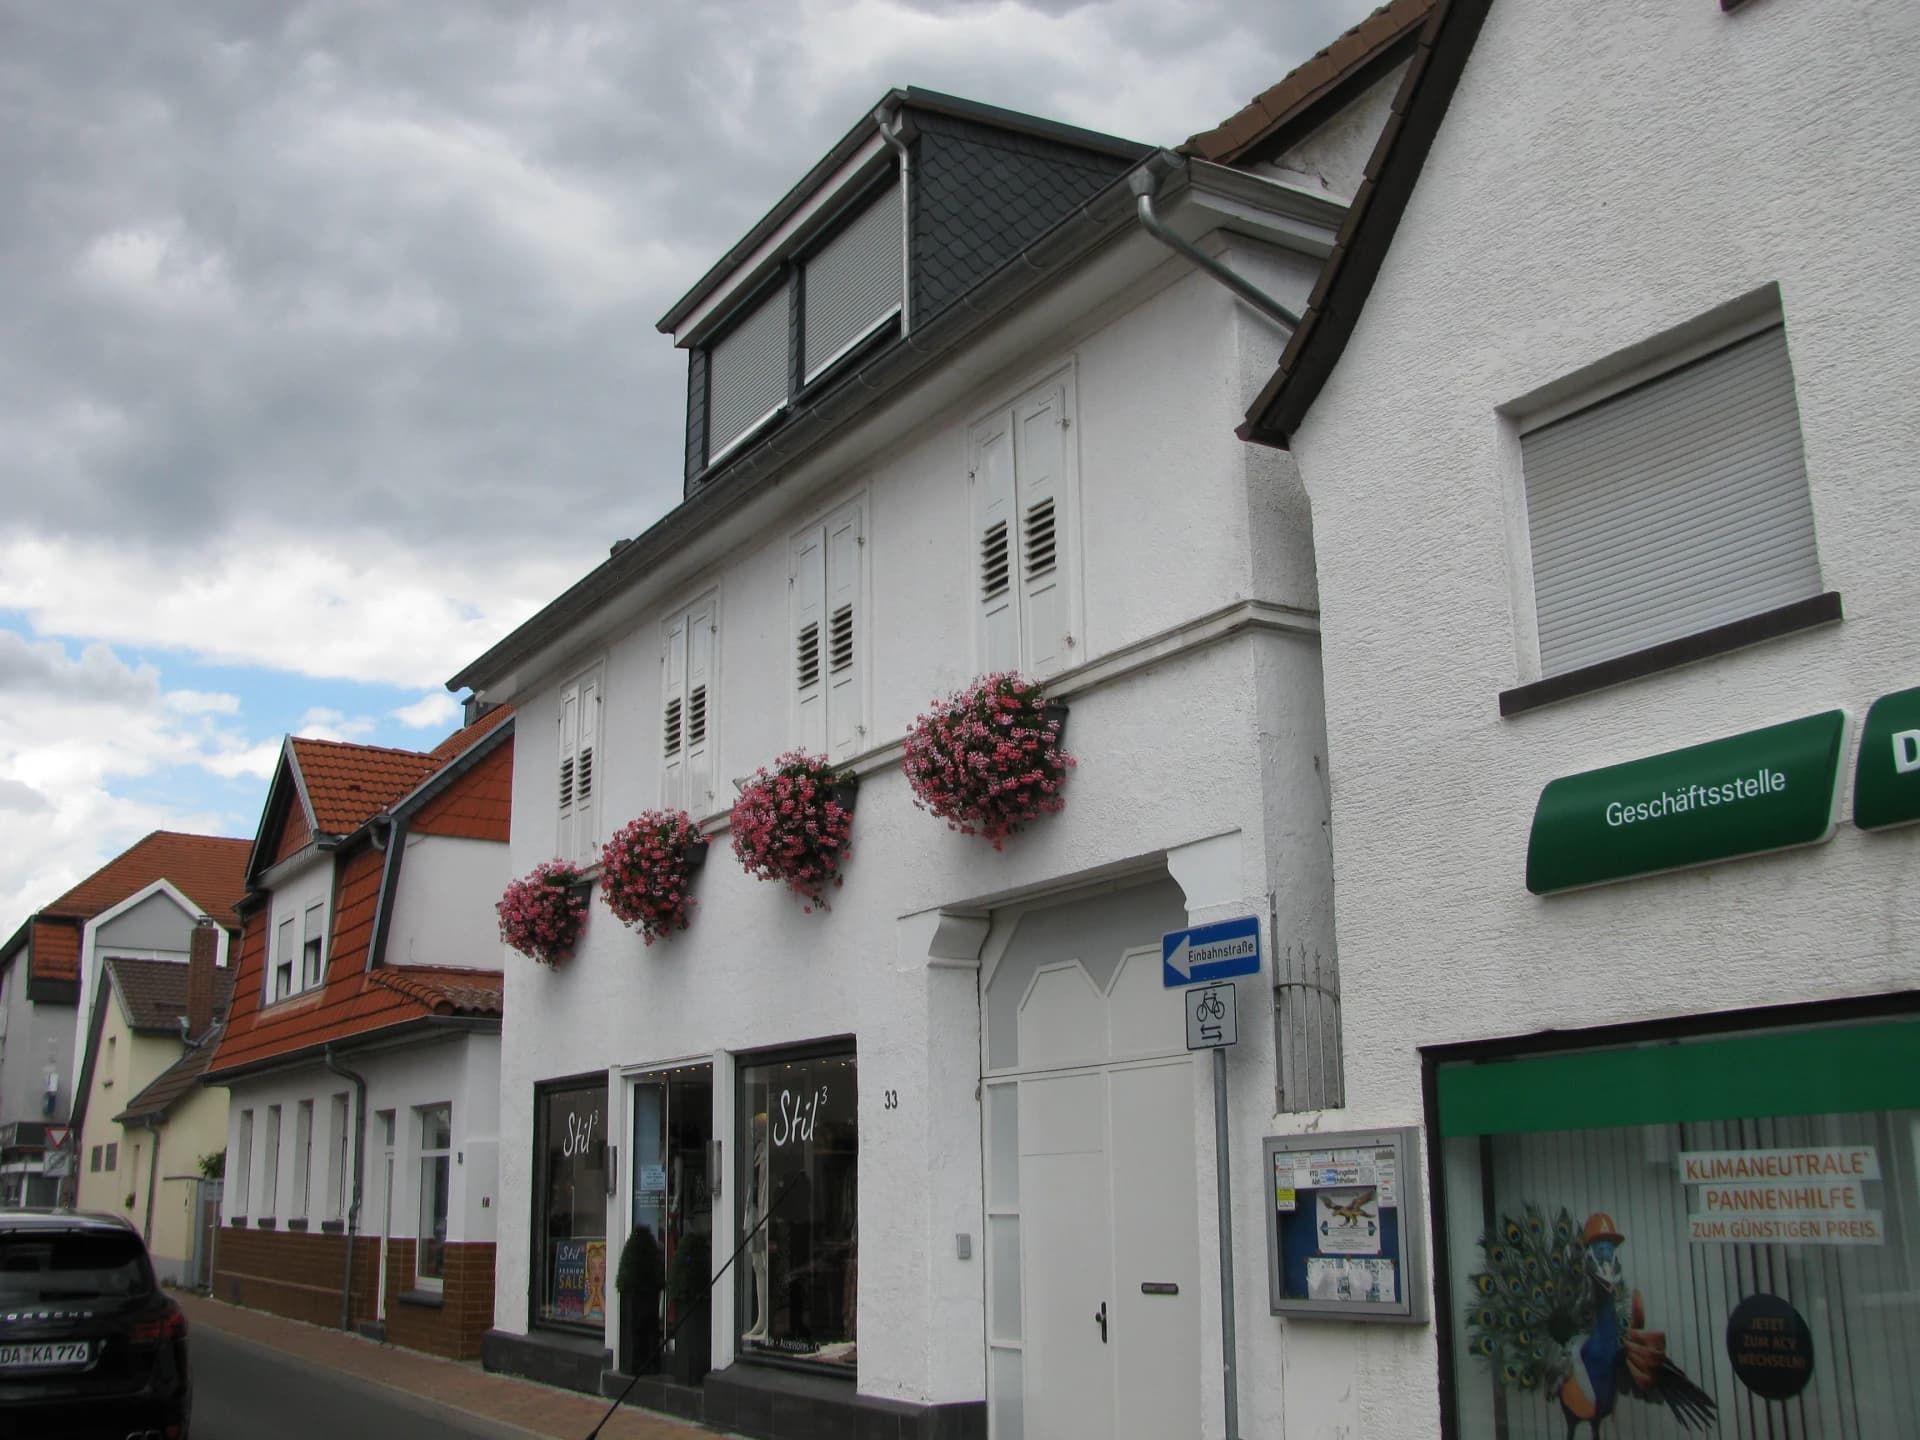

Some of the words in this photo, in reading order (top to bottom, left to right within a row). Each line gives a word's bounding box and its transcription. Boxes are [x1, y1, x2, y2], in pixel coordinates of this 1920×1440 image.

[1606, 768, 1786, 827] Geschäftsstelle
[1188, 940, 1254, 963] Einbahnstraße
[884, 1090, 898, 1109] 33
[1706, 1187, 1857, 1210] PANNENHILFE
[1692, 1222, 1726, 1238] ZUM
[1730, 1219, 1821, 1238] GÜNSTIGEN
[1825, 1221, 1880, 1238] PREIS.
[559, 1274, 584, 1288] SALE
[0, 1312, 93, 1320] ORSCHE
[1751, 1317, 1785, 1331] JETZT
[1743, 1335, 1769, 1349] ZUM
[0, 1348, 20, 1363] DA
[57, 1345, 86, 1361] 776
